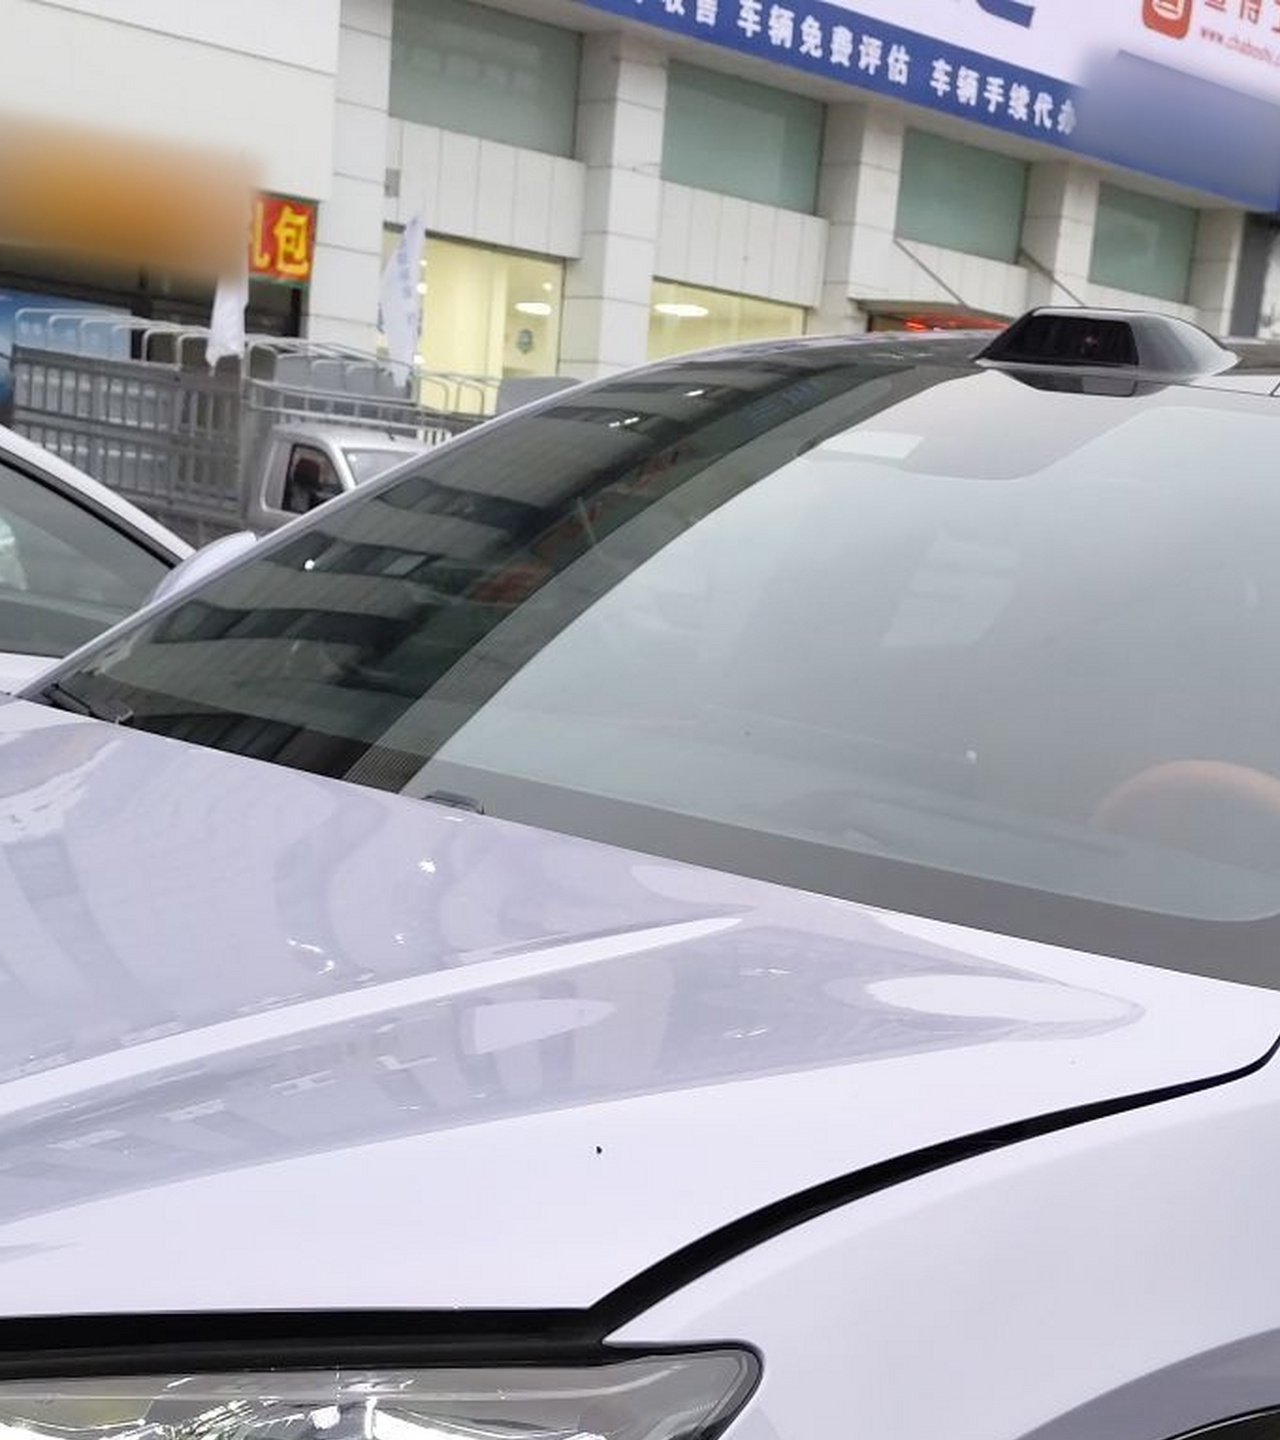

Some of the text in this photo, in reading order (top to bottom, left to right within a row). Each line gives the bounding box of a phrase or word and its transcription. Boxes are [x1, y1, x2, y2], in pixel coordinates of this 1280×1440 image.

[737, 0, 910, 85] 车辆免费评估
